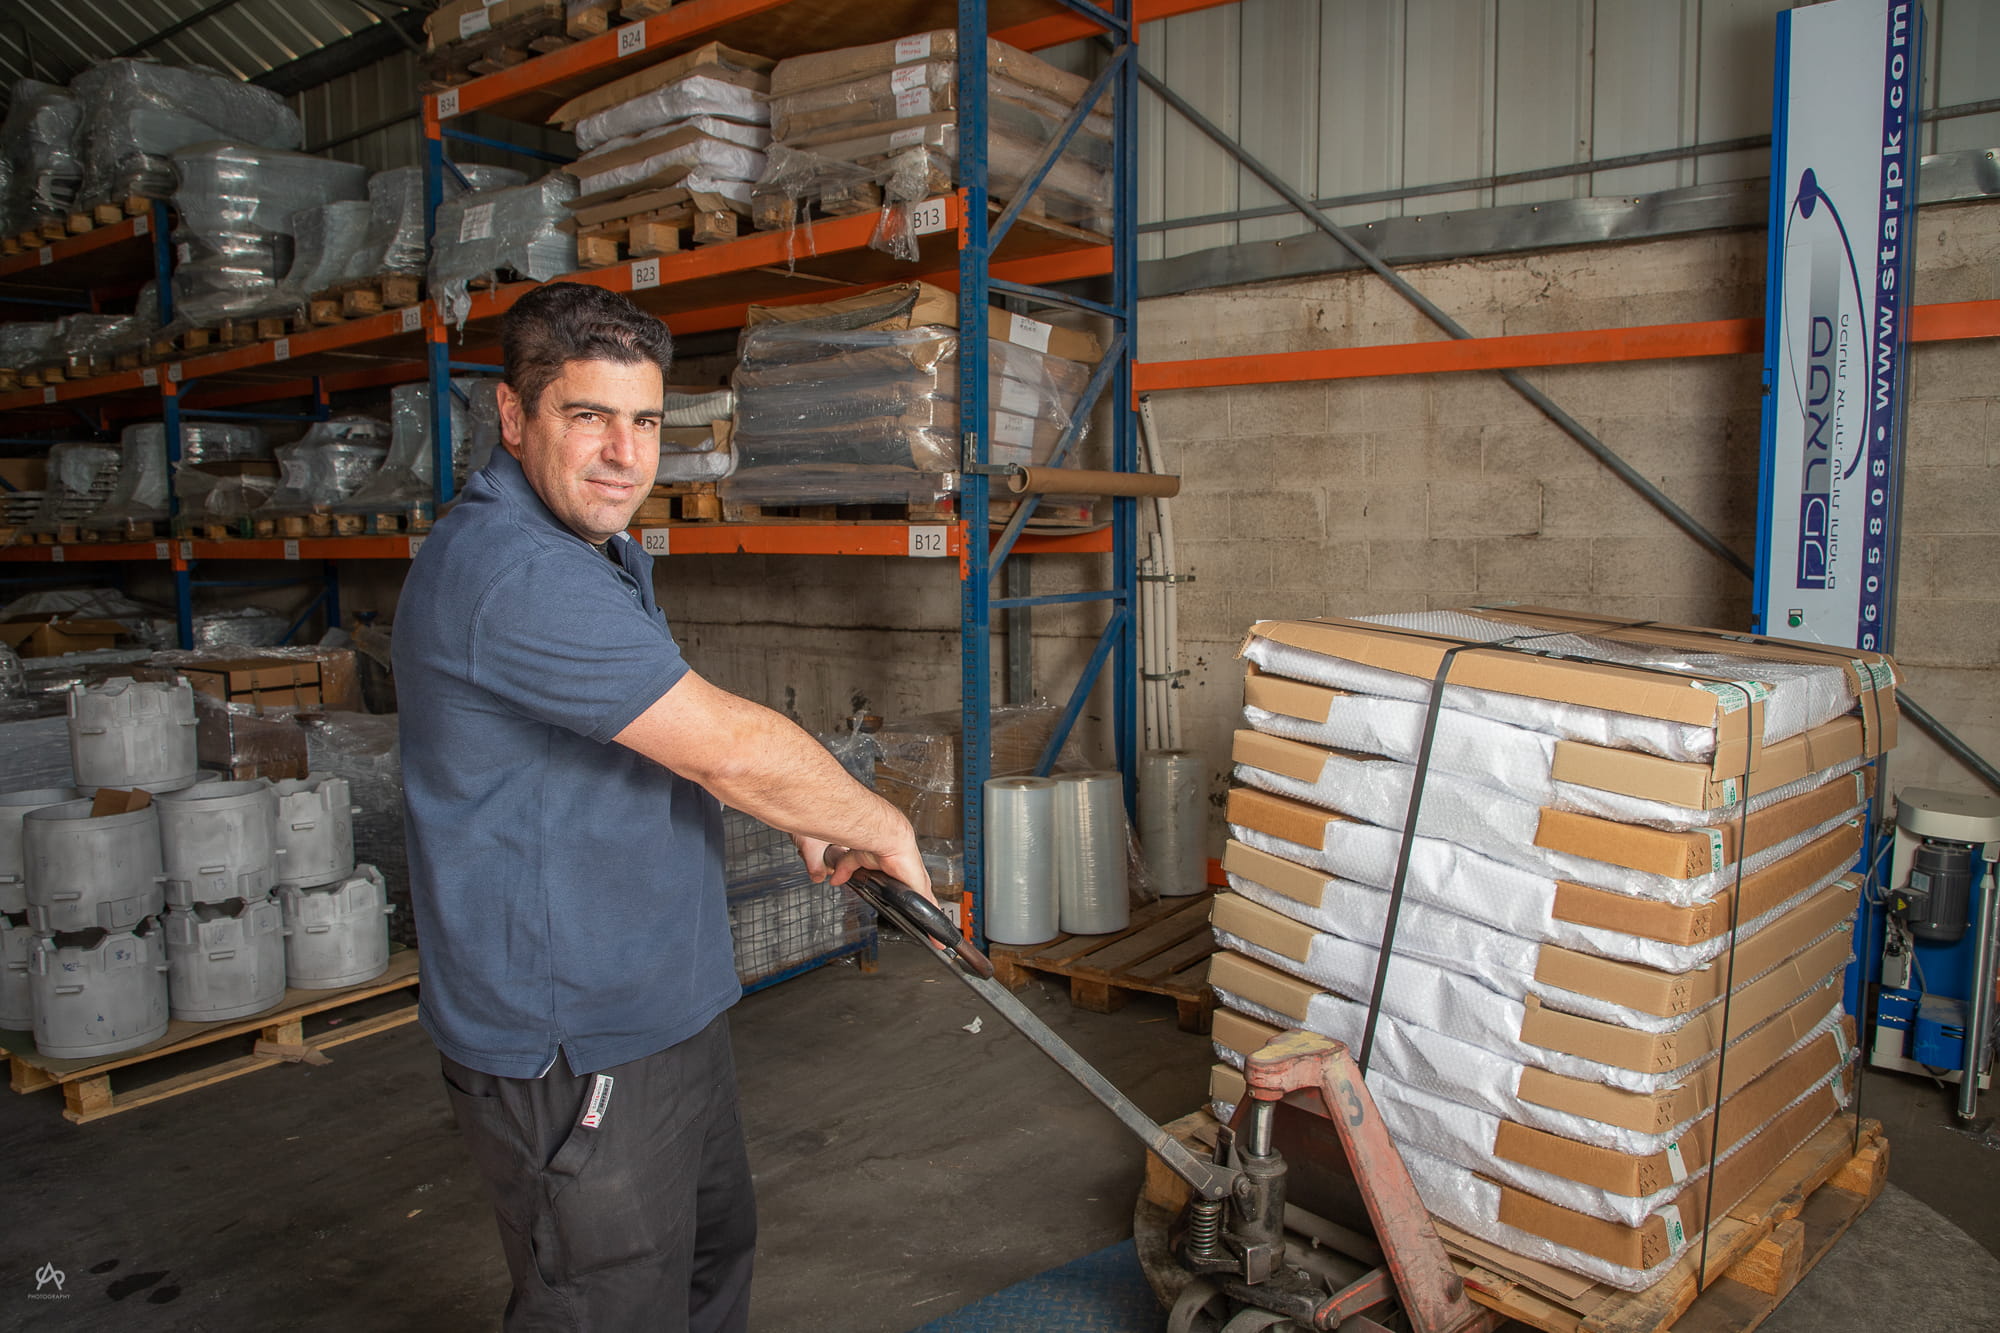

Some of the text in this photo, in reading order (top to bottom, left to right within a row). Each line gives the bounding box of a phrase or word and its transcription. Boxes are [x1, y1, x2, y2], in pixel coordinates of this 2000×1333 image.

[622, 29, 641, 49] B24
[440, 95, 456, 113] B34
[912, 207, 940, 229] B13
[636, 266, 655, 283] B23
[1862, 459, 1885, 650] 9605808
[1875, 4, 1907, 411] www.starpk.com
[1838, 313, 1850, 380] מכונות
[1832, 458, 1843, 510] שרות
[646, 535, 665, 550] B22
[915, 534, 941, 551] B12
[1827, 518, 1839, 590] וחומרים
[1339, 1079, 1364, 1127] 3
